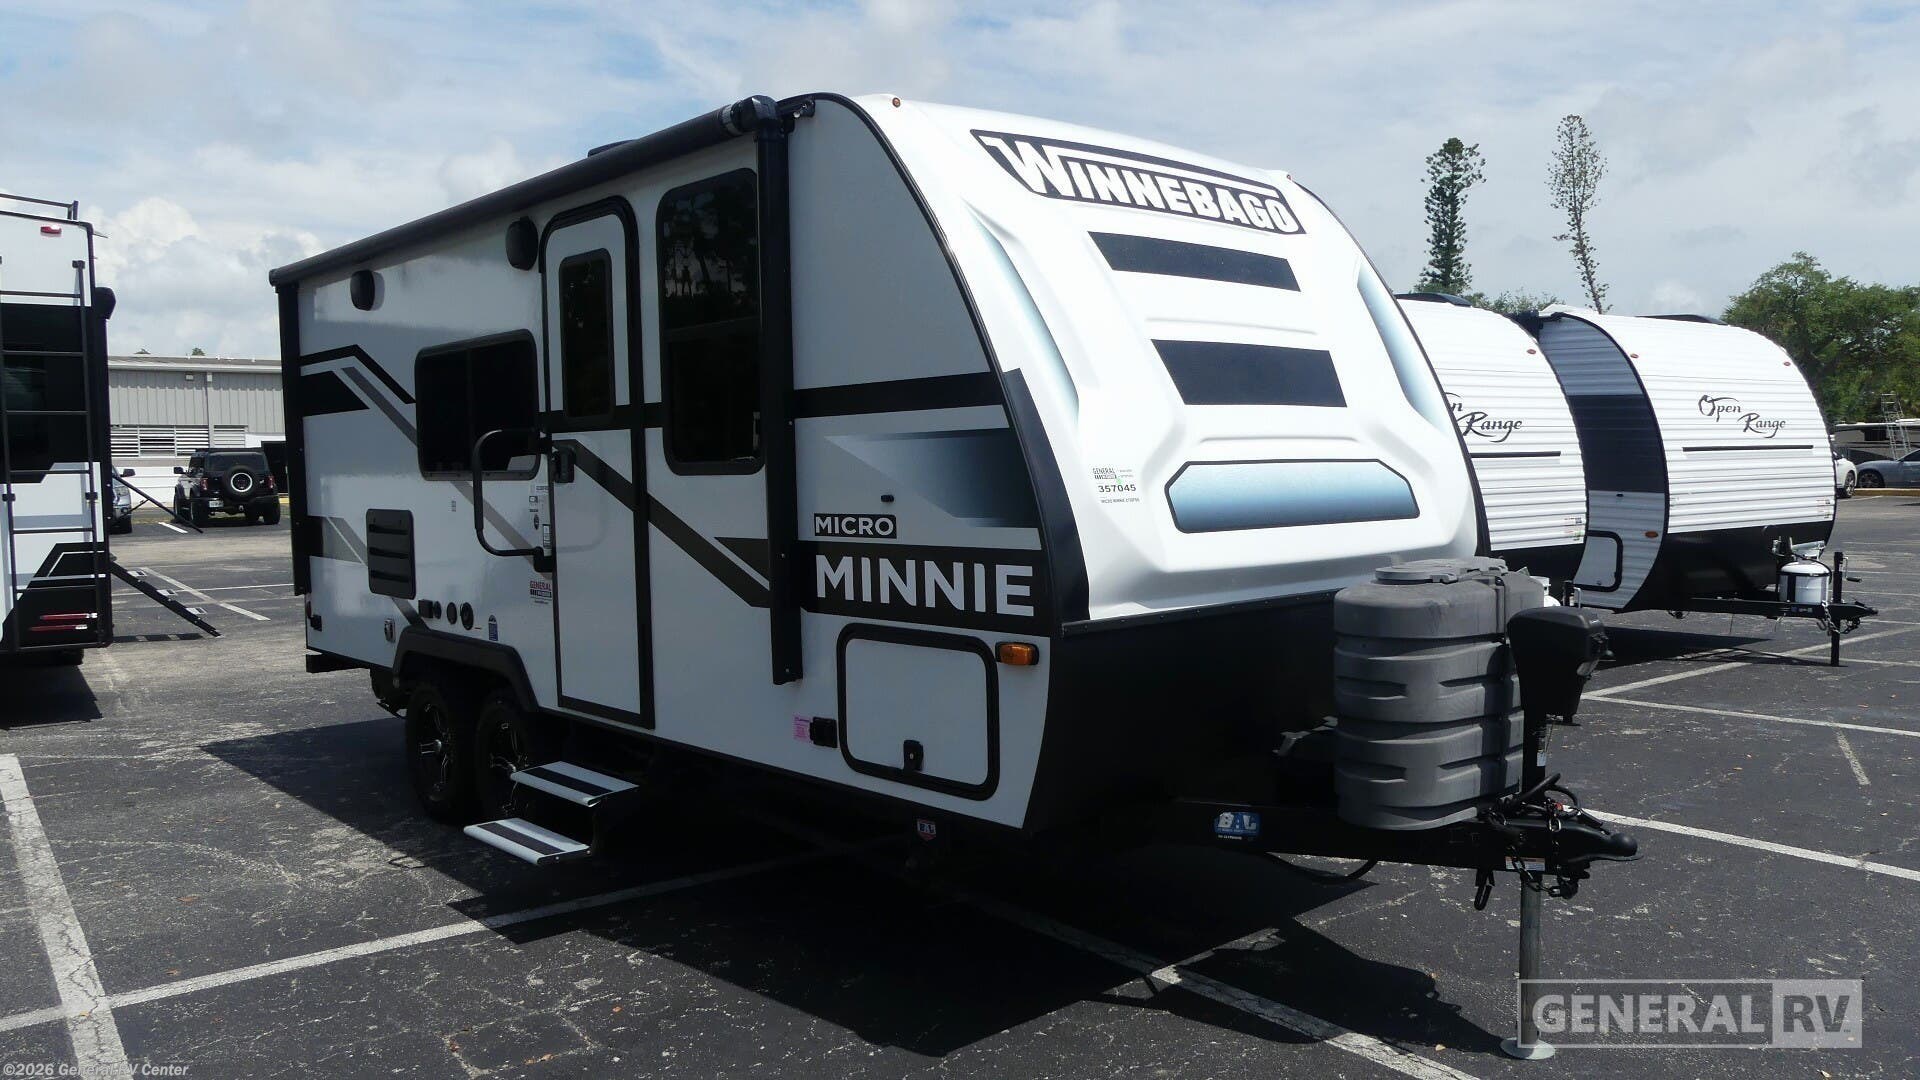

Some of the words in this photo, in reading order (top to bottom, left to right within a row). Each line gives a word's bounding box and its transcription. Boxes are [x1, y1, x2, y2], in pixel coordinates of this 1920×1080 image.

[979, 135, 1299, 233] WINNEBAGO
[1698, 394, 1741, 422] Open
[1456, 411, 1523, 443] Range
[1737, 412, 1786, 439] Range
[1097, 484, 1137, 493] 357045
[815, 516, 894, 536] MICRO
[816, 554, 1035, 617] MINNIE
